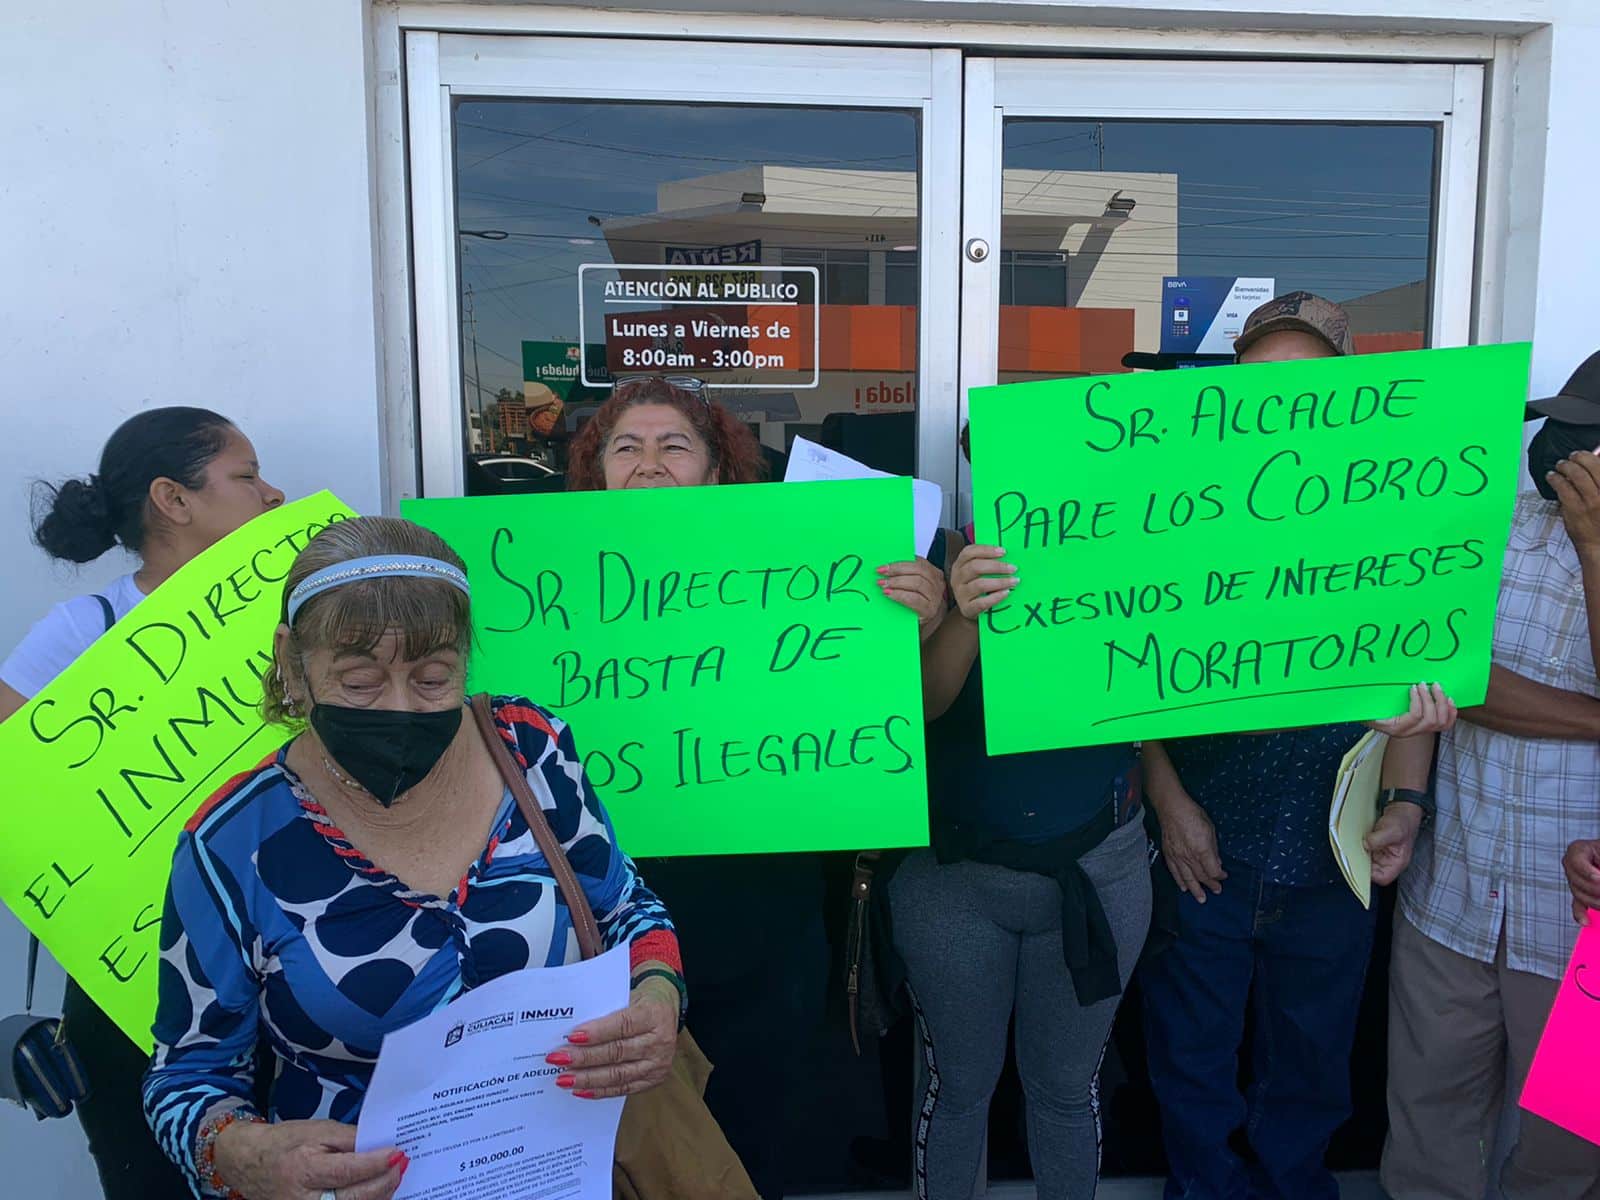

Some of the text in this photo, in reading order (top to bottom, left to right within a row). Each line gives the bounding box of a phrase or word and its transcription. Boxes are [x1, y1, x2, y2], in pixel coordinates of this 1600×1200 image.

[604, 277, 799, 300] ATENCIÓN AL PUBLICO
[612, 319, 791, 339] Lunes a Viernes de
[623, 348, 695, 367] 8:00am
[712, 349, 785, 369] 3:00pm
[1191, 379, 1426, 443] ALCALDE
[994, 445, 1490, 550] PARE LOS COBROS
[598, 550, 870, 625] DIRECTOR
[984, 539, 1486, 635] EXESIVOS DE INTERESES
[546, 623, 864, 709] BASTA DE
[1104, 607, 1468, 701] MORATORIOS
[585, 714, 915, 794] OS ILEGALES
[24, 861, 94, 920] EL
[521, 1007, 574, 1020] INMUVI
[432, 1076, 505, 1101] NOTIFICACIÓN
[507, 1072, 521, 1083] DE
[460, 1145, 525, 1173] $ 190,000.00
